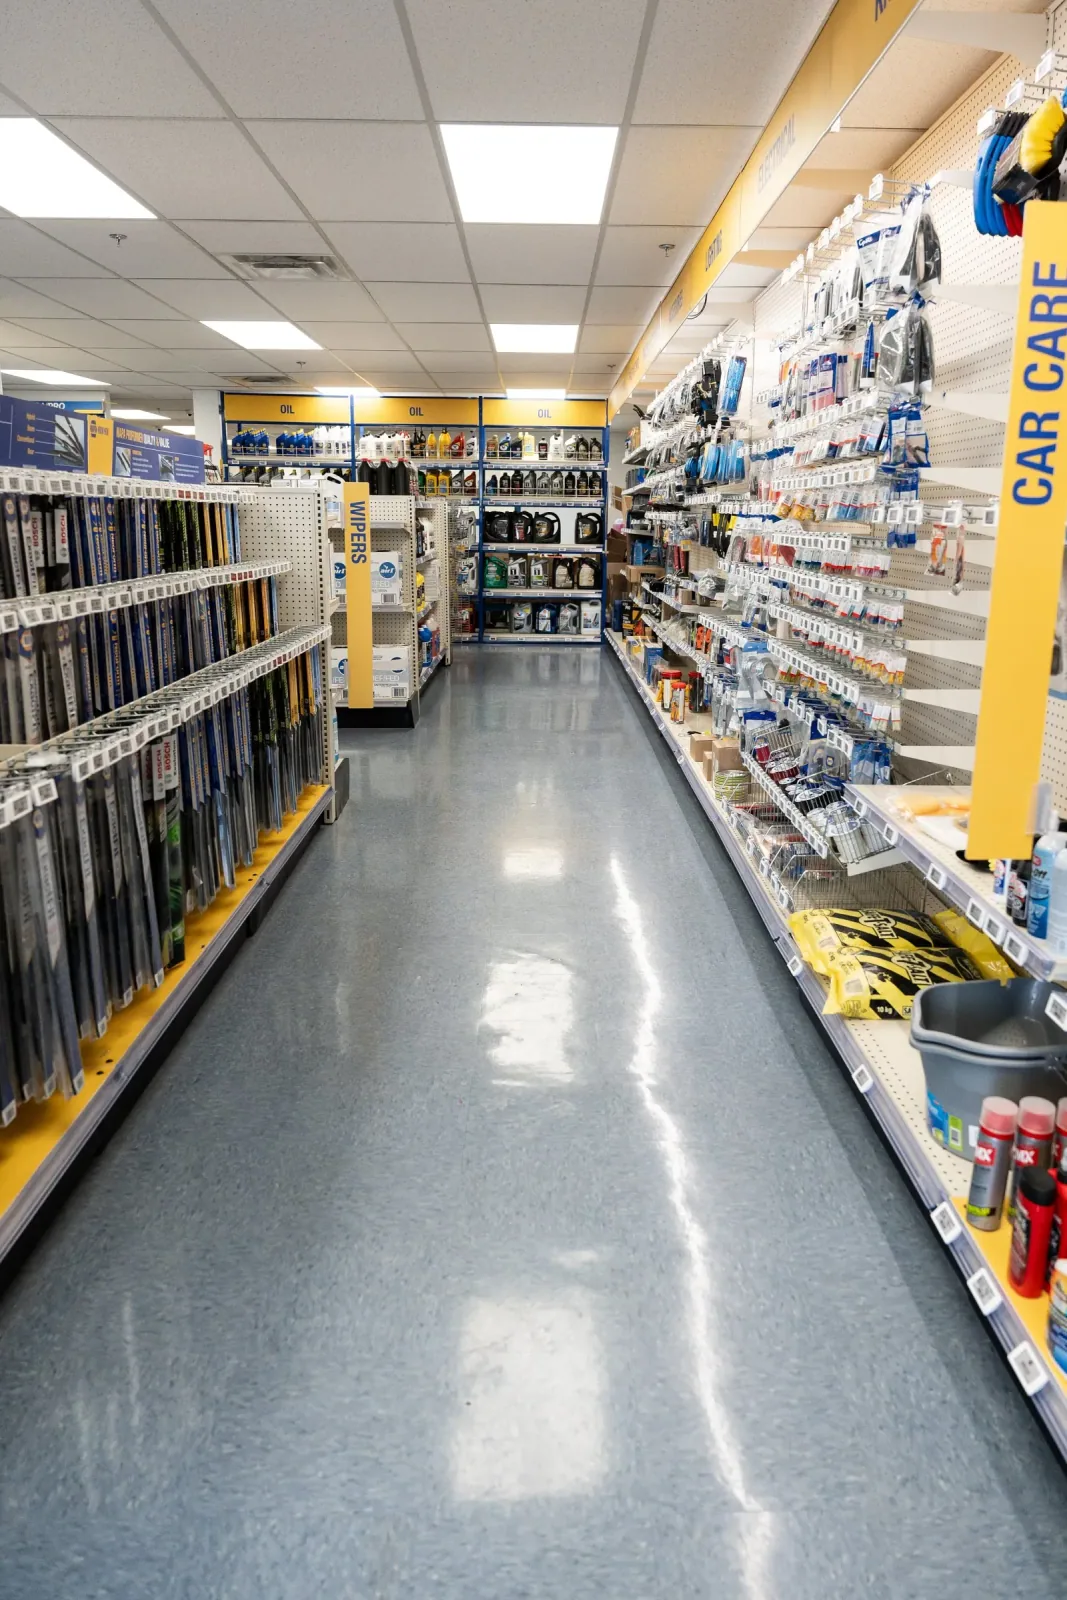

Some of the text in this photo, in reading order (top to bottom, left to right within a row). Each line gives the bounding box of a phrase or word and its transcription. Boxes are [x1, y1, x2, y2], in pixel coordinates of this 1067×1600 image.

[758, 112, 796, 194] ELECTRICAL
[1012, 261, 1067, 506] CAR CARE
[280, 404, 295, 414] OIL
[409, 406, 424, 416] OIL
[537, 409, 552, 418] OIL
[349, 501, 367, 564] WIPERS
[163, 741, 171, 771] BOSCH
[876, 1006, 885, 1014] 10
